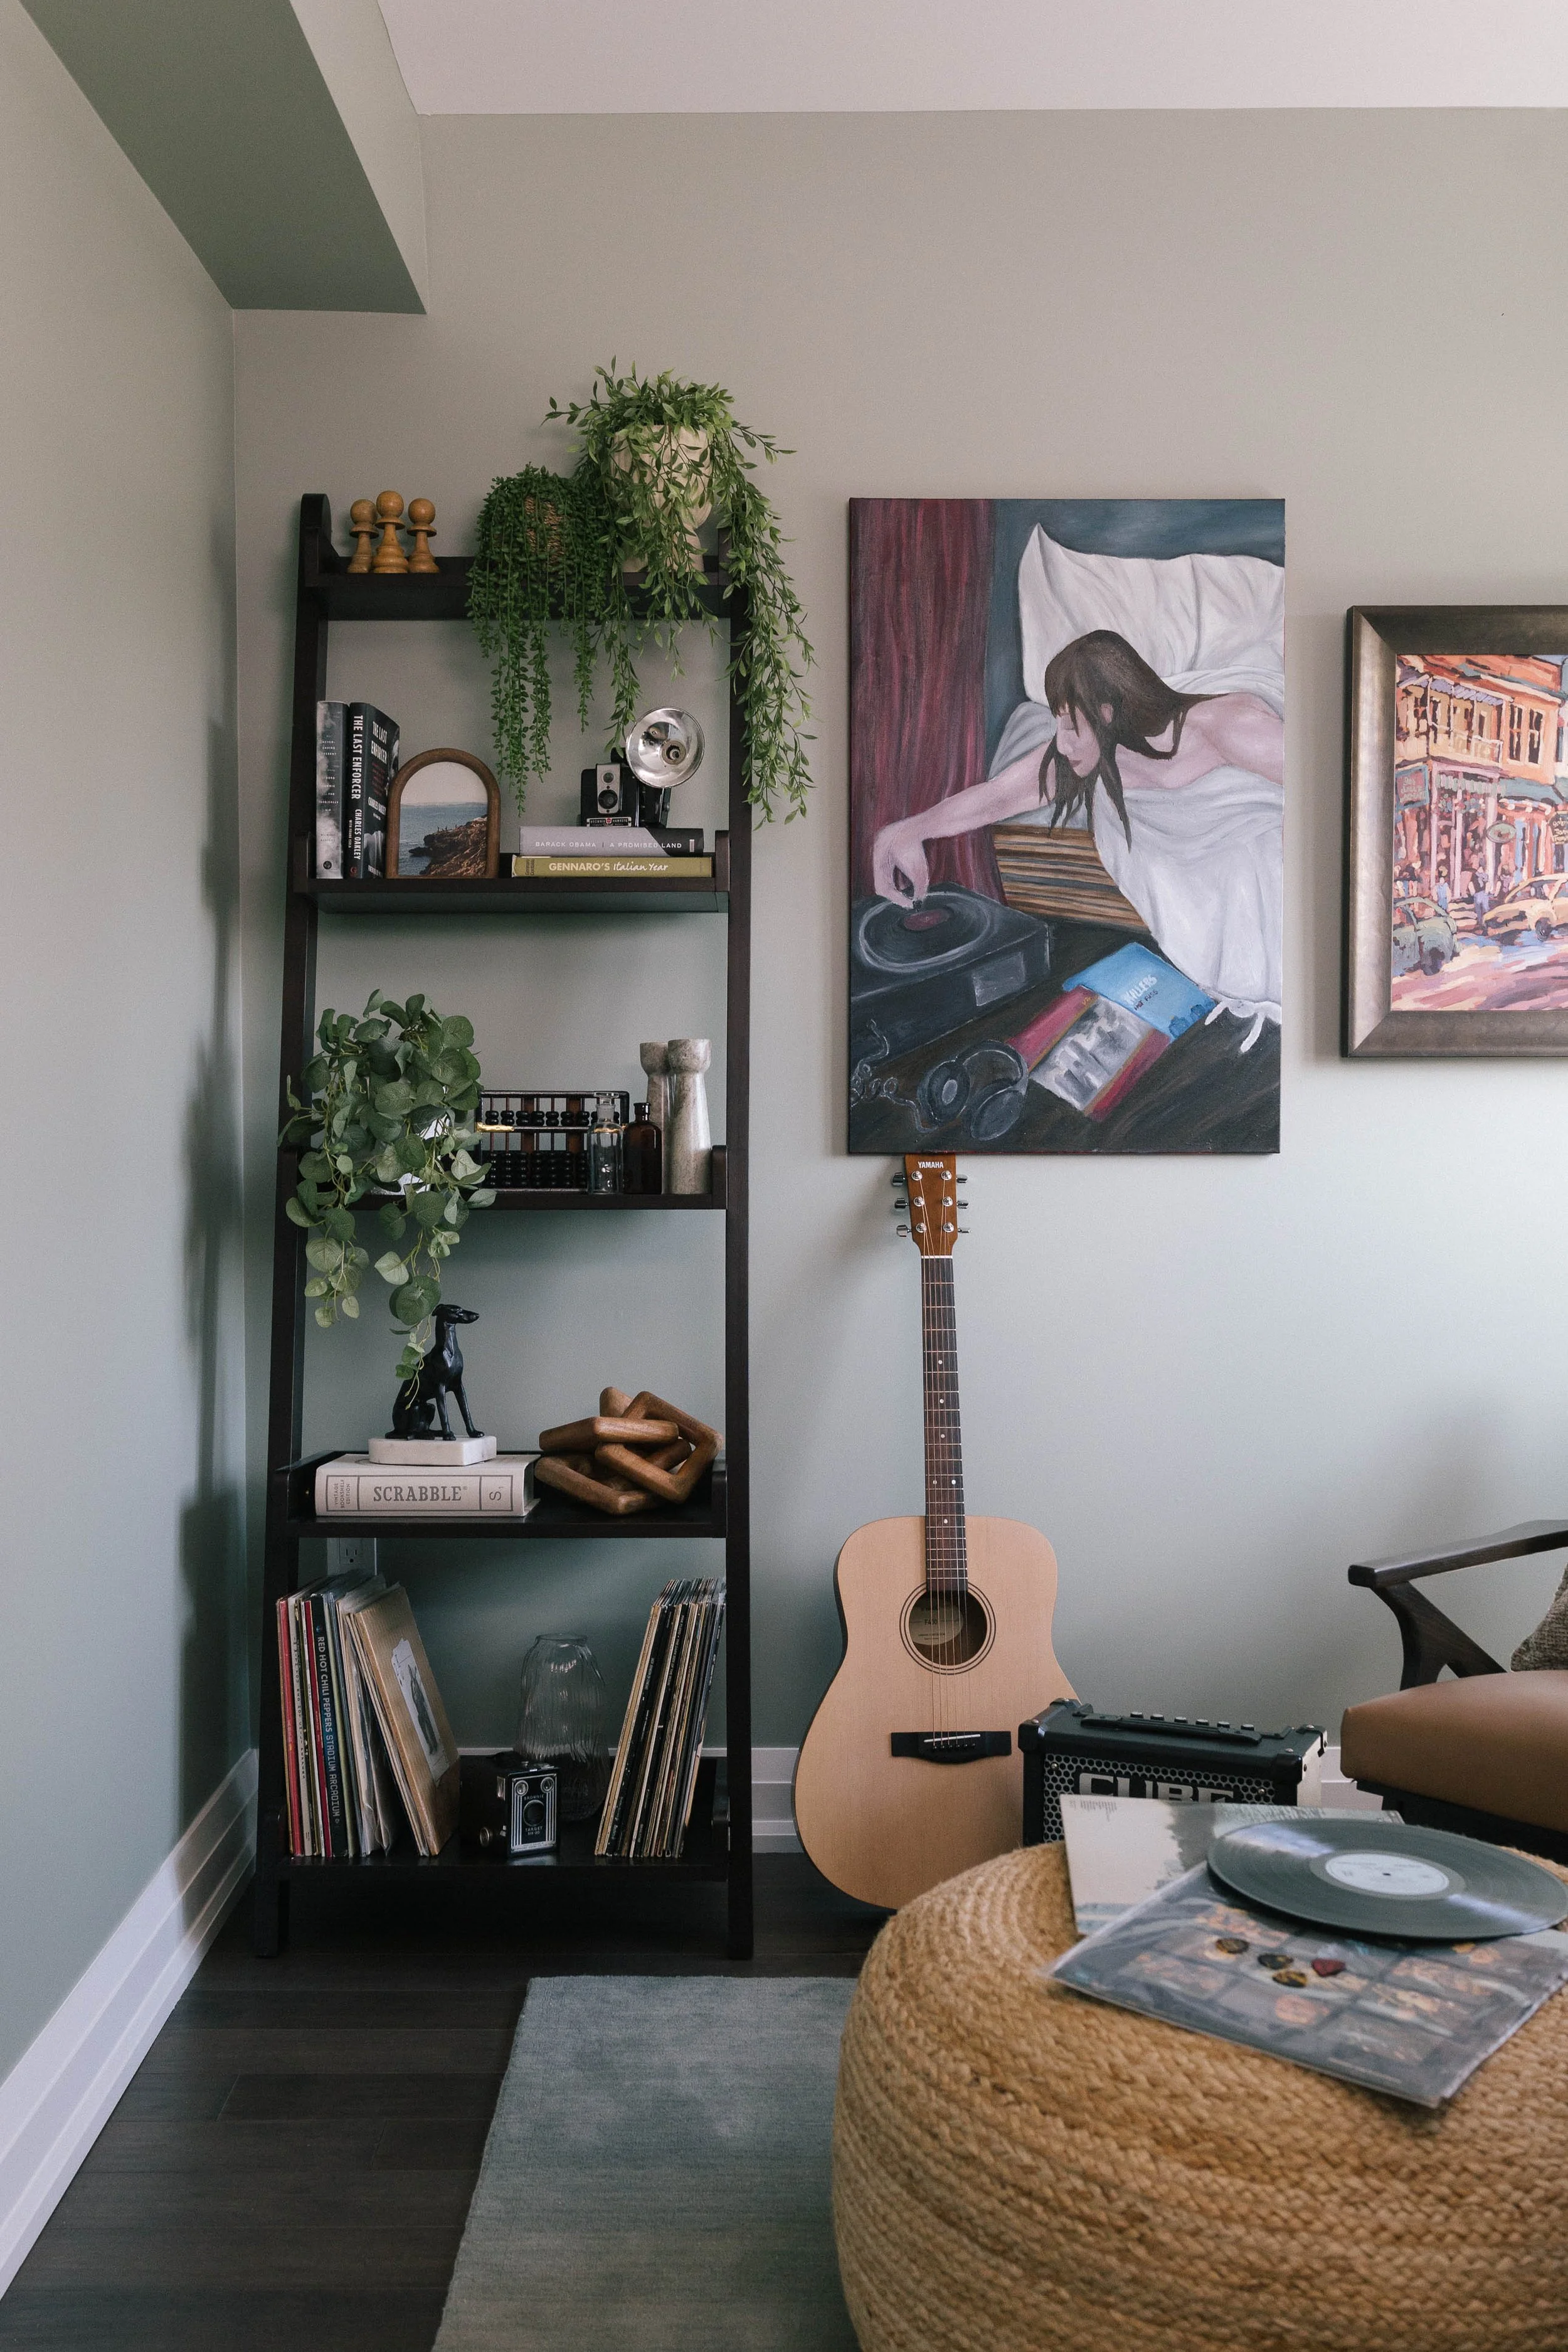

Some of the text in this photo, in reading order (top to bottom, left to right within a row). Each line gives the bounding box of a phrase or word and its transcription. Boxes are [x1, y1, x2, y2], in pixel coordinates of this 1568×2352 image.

[371, 740, 387, 765] ENFORCER
[378, 726, 387, 744] LAST
[351, 715, 363, 800] THE LAST ENFORCER
[353, 808, 363, 860] CHARLES OAKLEY
[549, 861, 669, 872] GENNARO'S Italian Year
[317, 1636, 341, 1818] RED HOT CHILI PEPPERS STADIUM ARCADIUM
